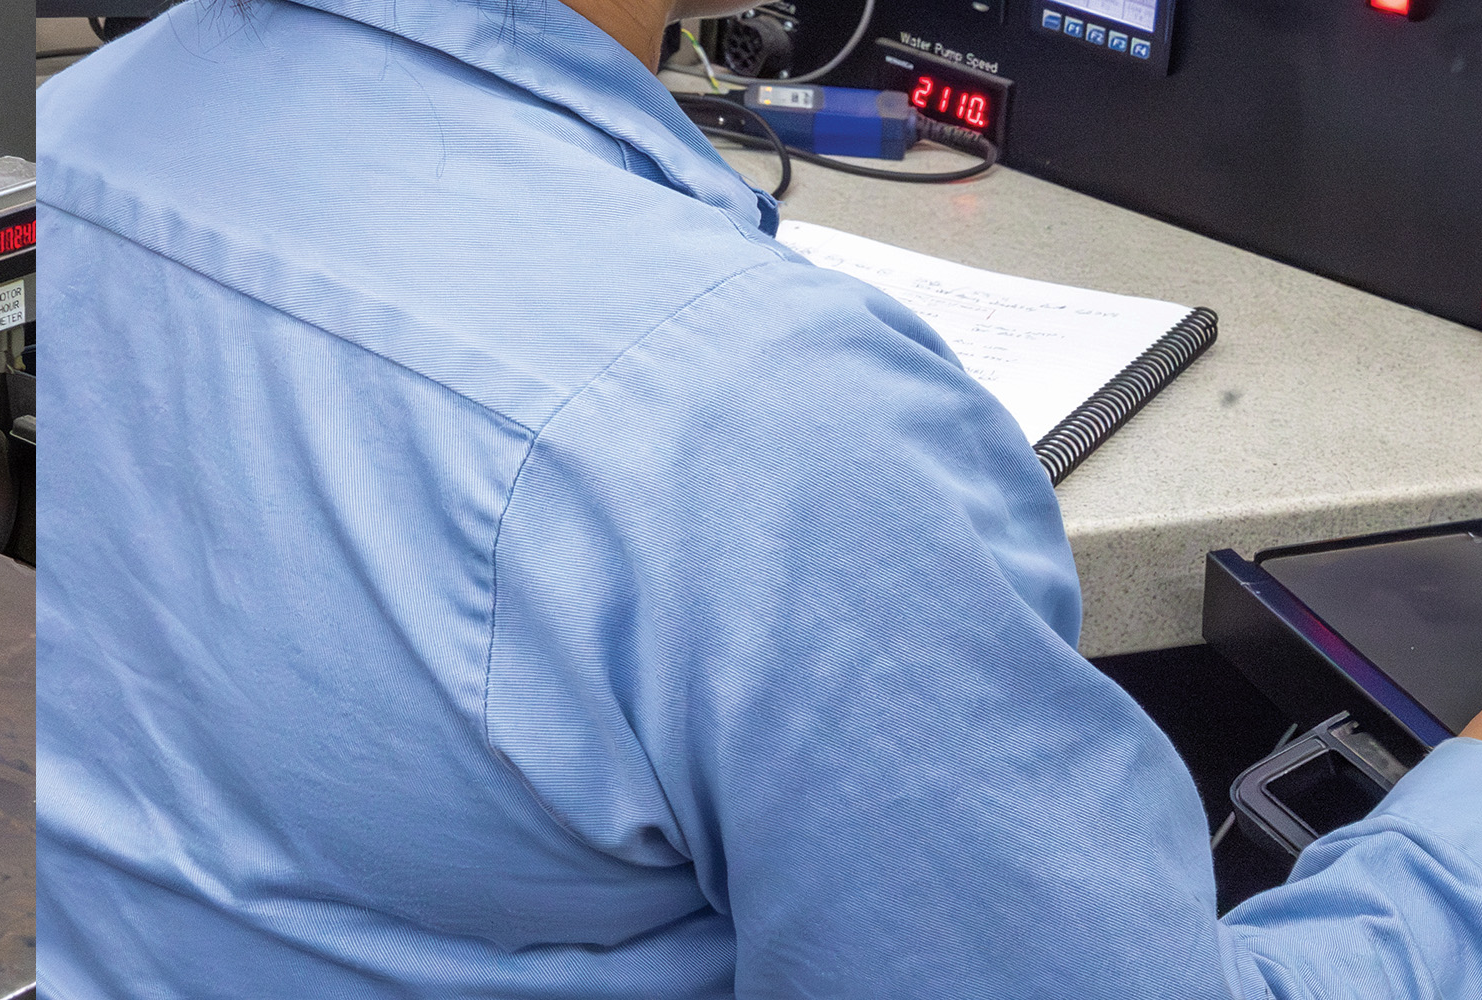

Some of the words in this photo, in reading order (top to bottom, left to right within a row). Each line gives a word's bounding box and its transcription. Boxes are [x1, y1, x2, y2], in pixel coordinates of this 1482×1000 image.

[900, 31, 930, 50] Water
[934, 42, 962, 64] Pump
[966, 52, 998, 73] Speed
